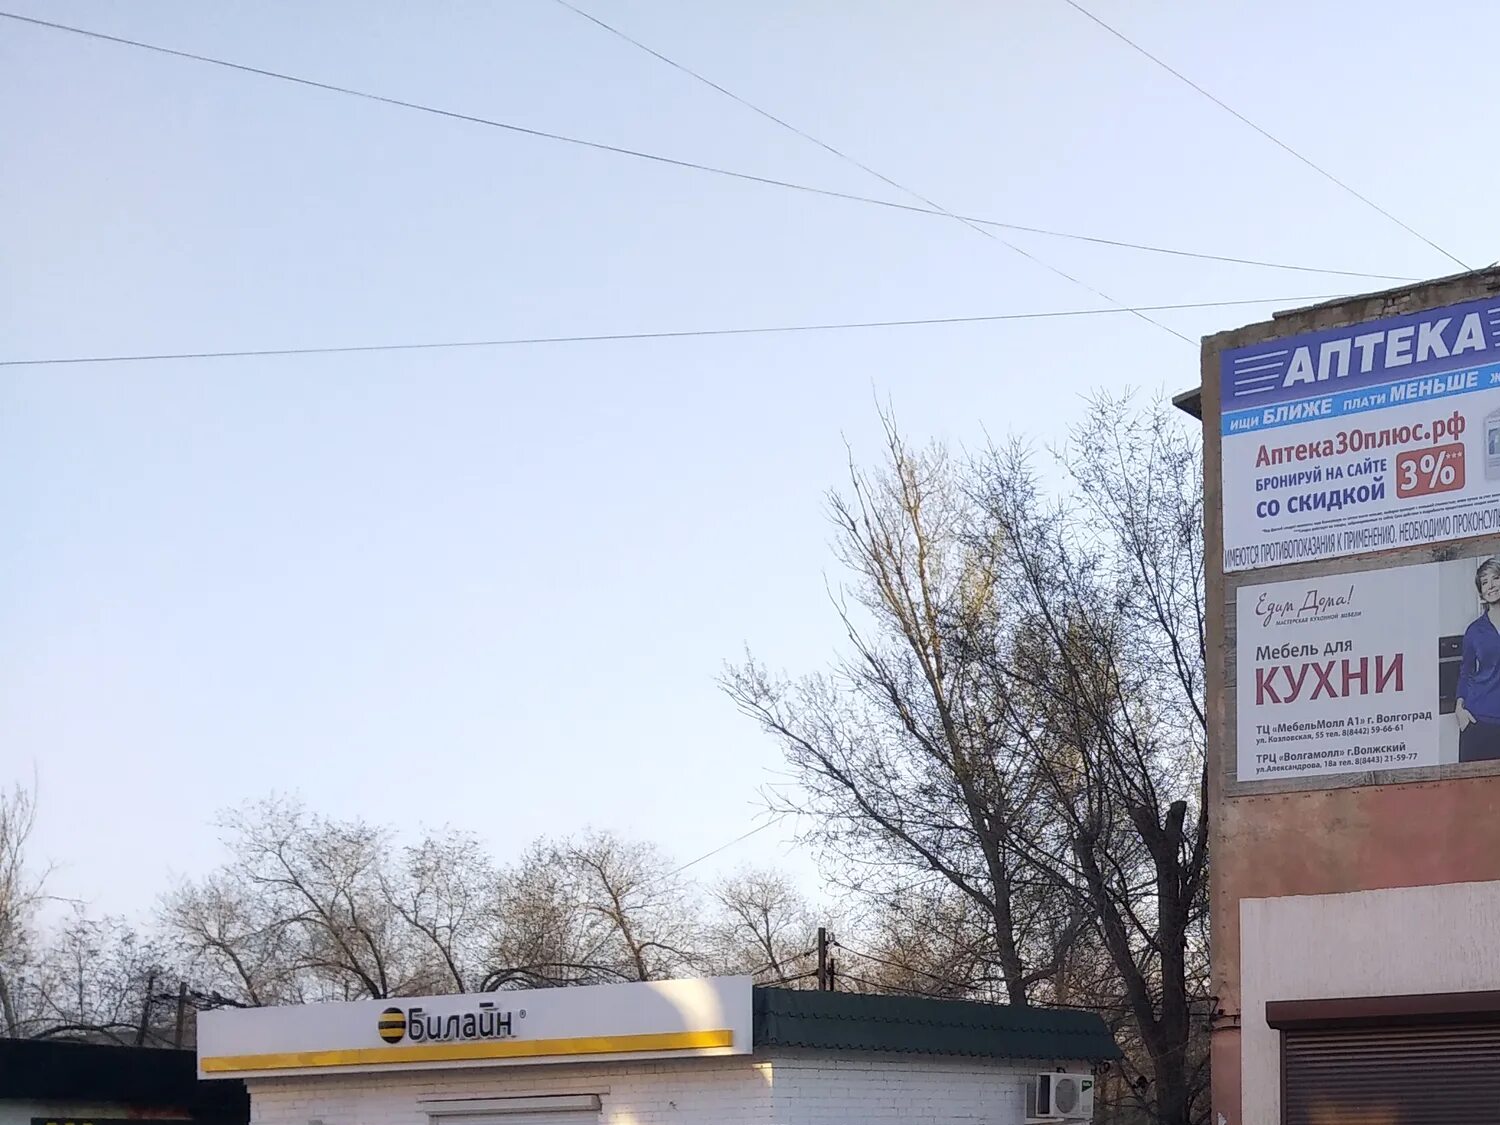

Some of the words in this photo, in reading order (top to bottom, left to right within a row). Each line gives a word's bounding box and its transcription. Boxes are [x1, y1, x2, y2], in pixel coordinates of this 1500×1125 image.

[1281, 312, 1488, 388] АПТЕКА
[1262, 398, 1333, 426] БЛИЖЕ
[1389, 370, 1479, 403] МЕНЬШЕ
[1255, 410, 1466, 469] Аптека30плюс.рф
[1255, 466, 1323, 493] БРОНИРУЙ
[1326, 467, 1344, 481] НА
[1347, 457, 1388, 478] САЙТЕ
[1224, 545, 1260, 569] ИМЕЮТСЯ
[1260, 533, 1336, 565] ПРОТИВОПОКАЗАНИЯ
[1337, 533, 1343, 551] К
[1343, 524, 1398, 550] ПРИМЕНЕНИЮ.
[1399, 517, 1451, 543] НЕОБХОДИМО
[1255, 592, 1294, 628] Едим
[1296, 584, 1355, 618] Дома!
[1255, 642, 1319, 661] Мебель
[1323, 639, 1353, 656] для
[1255, 653, 1404, 706] КУХНИ
[1255, 738, 1267, 746] ул.
[1268, 733, 1314, 744] Козловская,
[1315, 731, 1324, 739] 55
[1326, 730, 1341, 738] тел.
[1342, 728, 1370, 738] 8(8442)
[1371, 723, 1404, 734] 59-66-61
[1256, 725, 1271, 736] ТЦ
[1272, 718, 1345, 734] «МебельМолл
[1367, 717, 1375, 725] г.
[1376, 710, 1433, 723] Волгоград
[1256, 753, 1277, 765] ТРЦ
[1278, 749, 1345, 763] «Волгамолл»
[1347, 742, 1407, 757] г.Волжский
[1324, 759, 1337, 768] 18а
[1339, 758, 1354, 767] тел.
[1355, 756, 1383, 767] 8(8443)
[1384, 752, 1418, 763] 21-59-77
[407, 1002, 513, 1042] билайн
